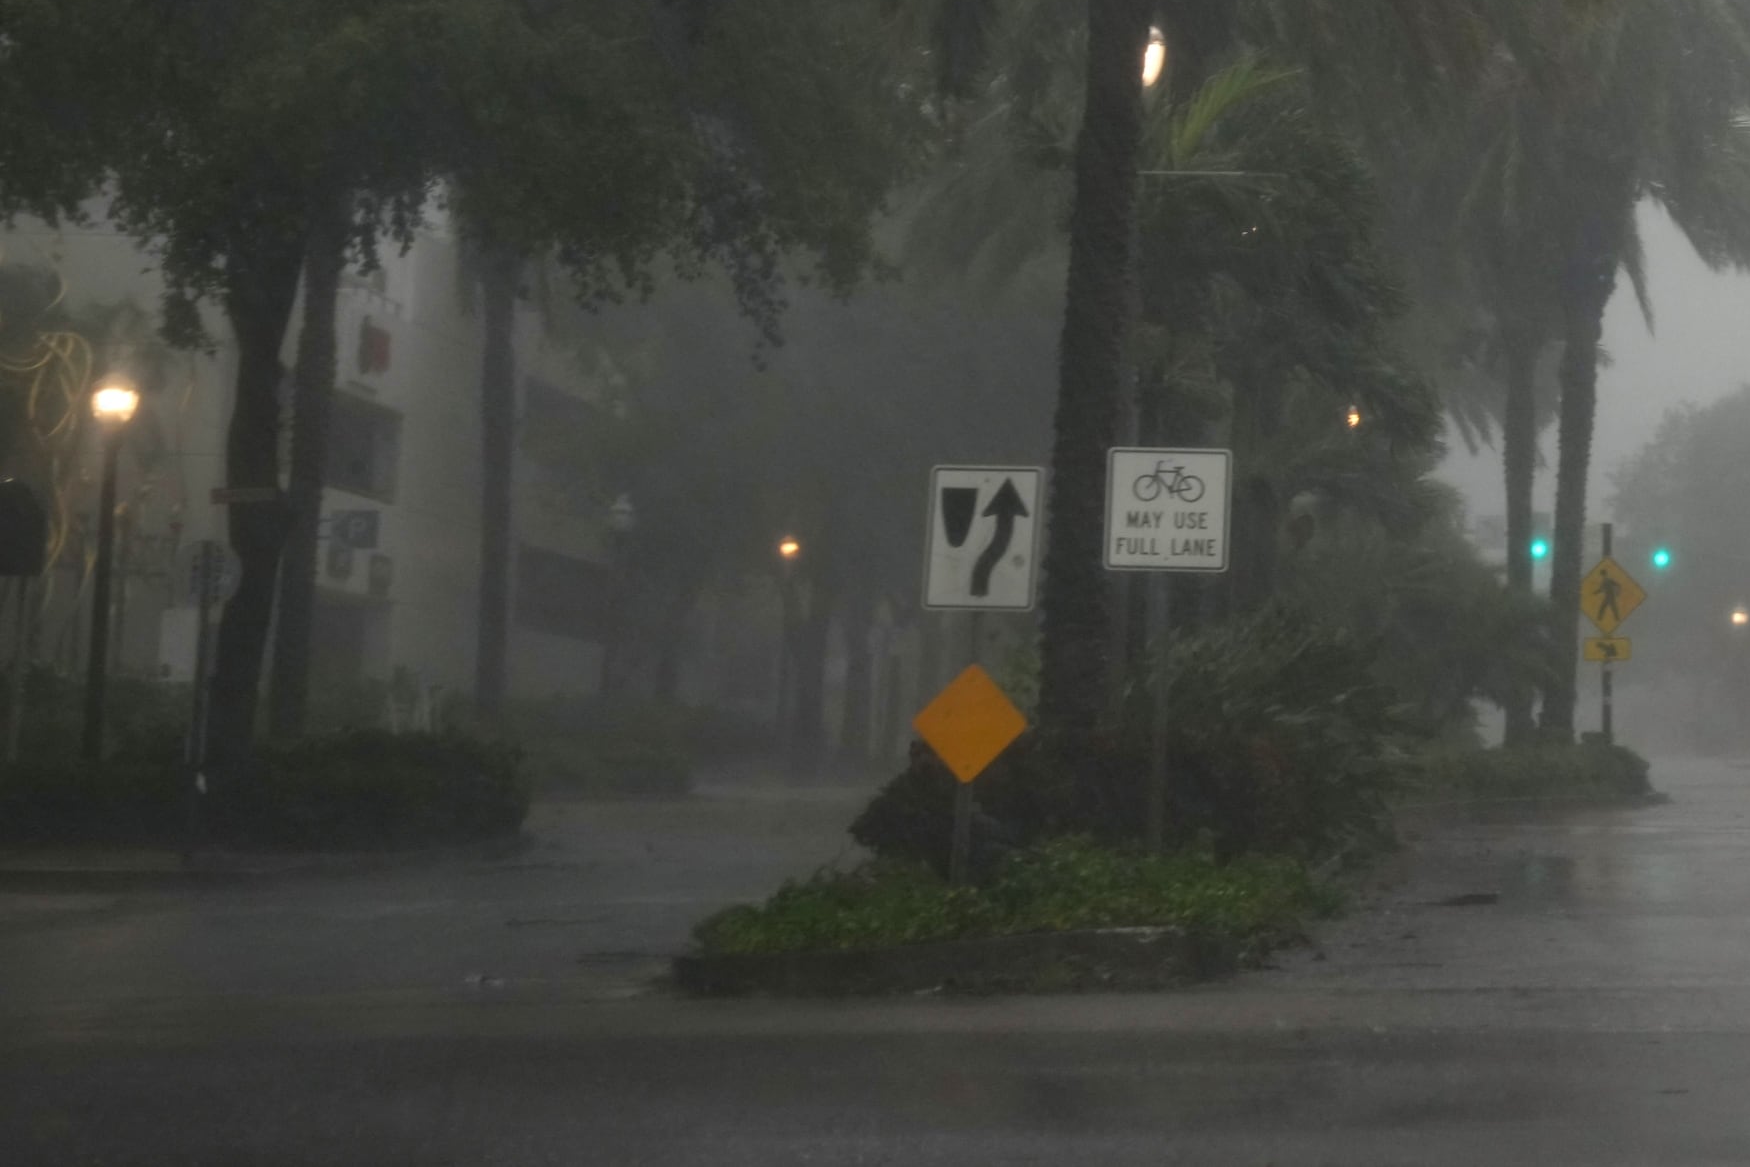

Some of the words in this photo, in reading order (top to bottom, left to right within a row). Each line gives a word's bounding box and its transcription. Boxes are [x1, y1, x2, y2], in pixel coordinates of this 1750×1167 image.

[1126, 511, 1163, 529] MAY
[1174, 512, 1208, 530] USE
[1115, 537, 1161, 555] FULL
[1171, 539, 1217, 557] LANE
